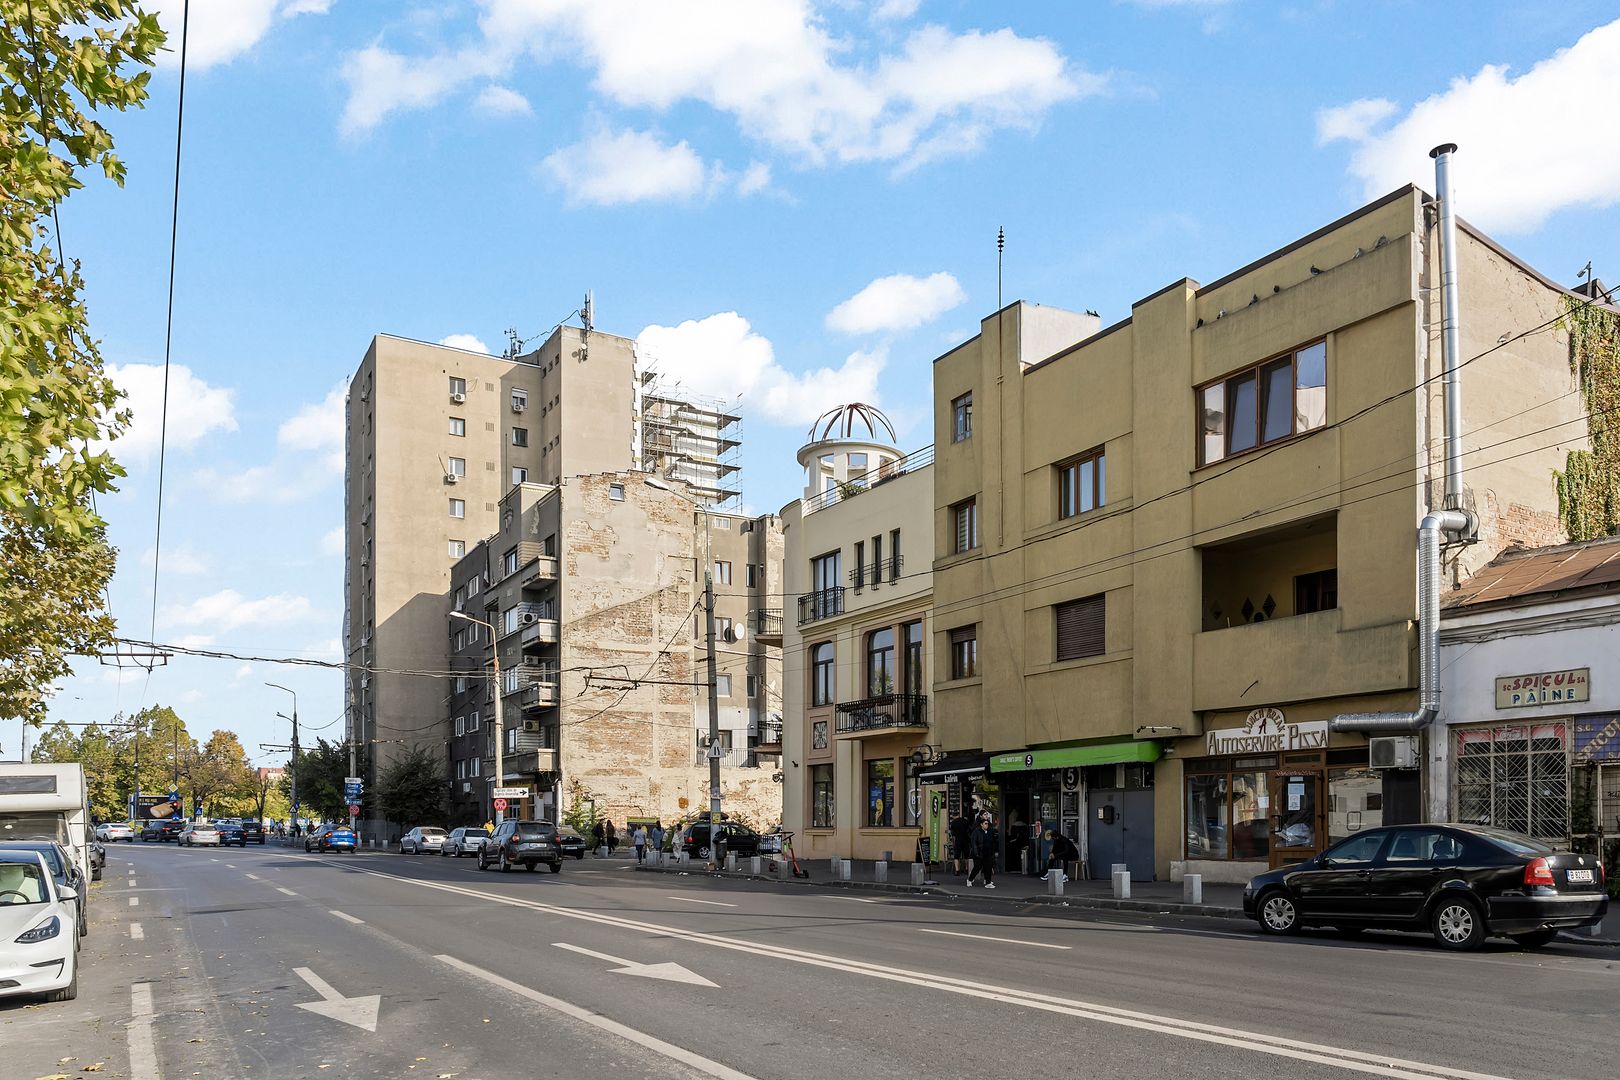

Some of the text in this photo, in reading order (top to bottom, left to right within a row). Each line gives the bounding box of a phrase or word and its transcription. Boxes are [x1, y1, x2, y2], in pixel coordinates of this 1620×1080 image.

[1512, 673, 1576, 691] SPICUL
[1242, 708, 1286, 735] LUNCH BREAK
[1207, 732, 1286, 756] AUTOSERVIRE
[1067, 768, 1075, 784] 5
